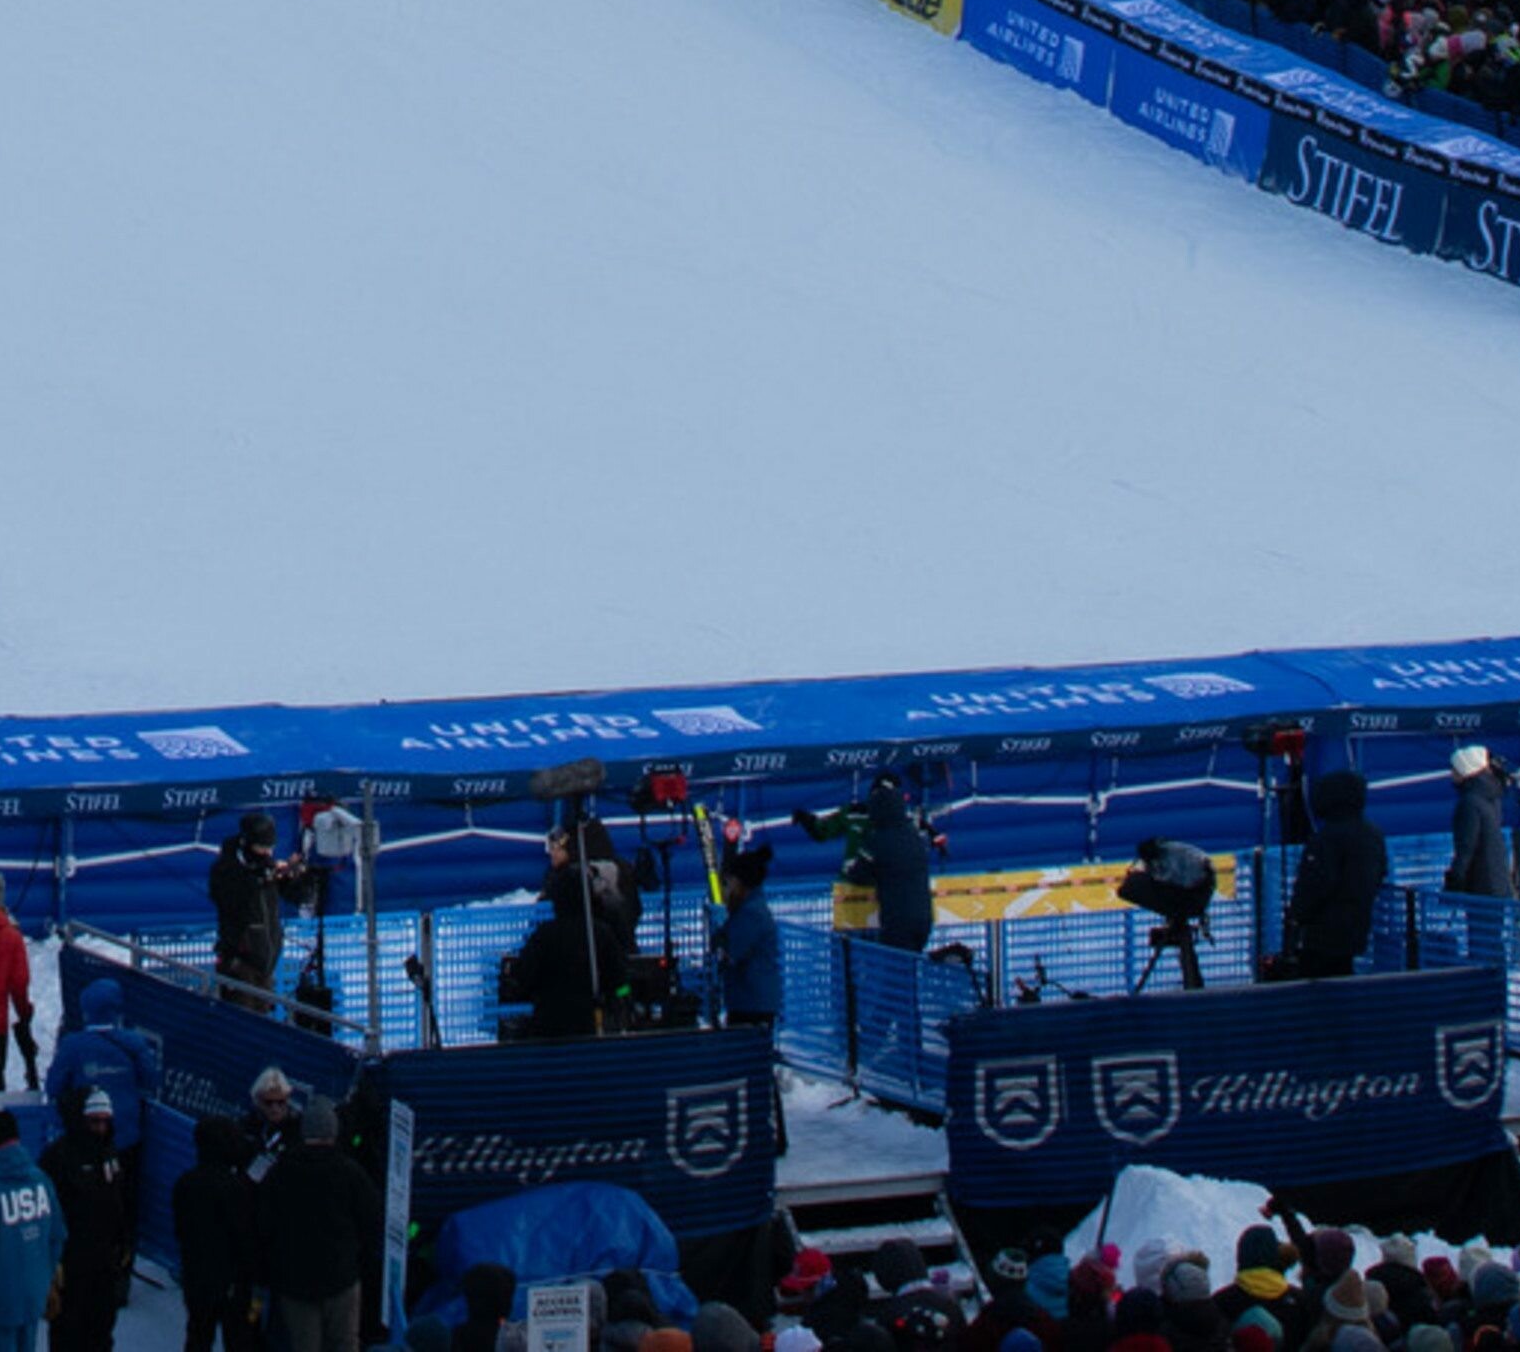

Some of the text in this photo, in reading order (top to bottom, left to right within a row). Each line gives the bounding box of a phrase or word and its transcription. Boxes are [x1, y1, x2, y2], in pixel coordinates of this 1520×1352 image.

[1006, 10, 1060, 47] UNITED
[1154, 86, 1209, 123] UNITED
[1287, 133, 1405, 242] STIFEL
[905, 690, 1157, 721] AIRLINES
[930, 681, 1135, 707] UNITED
[399, 726, 662, 751] AIRLINES
[429, 711, 641, 738] UNITED
[731, 753, 788, 772] STIFEL
[163, 787, 220, 807] STIFEL
[453, 777, 507, 794] STIFEL
[64, 793, 121, 812] STIFEL
[1189, 1070, 1421, 1122] Killington
[413, 1134, 648, 1185] Killington
[0, 1182, 51, 1226] USA
